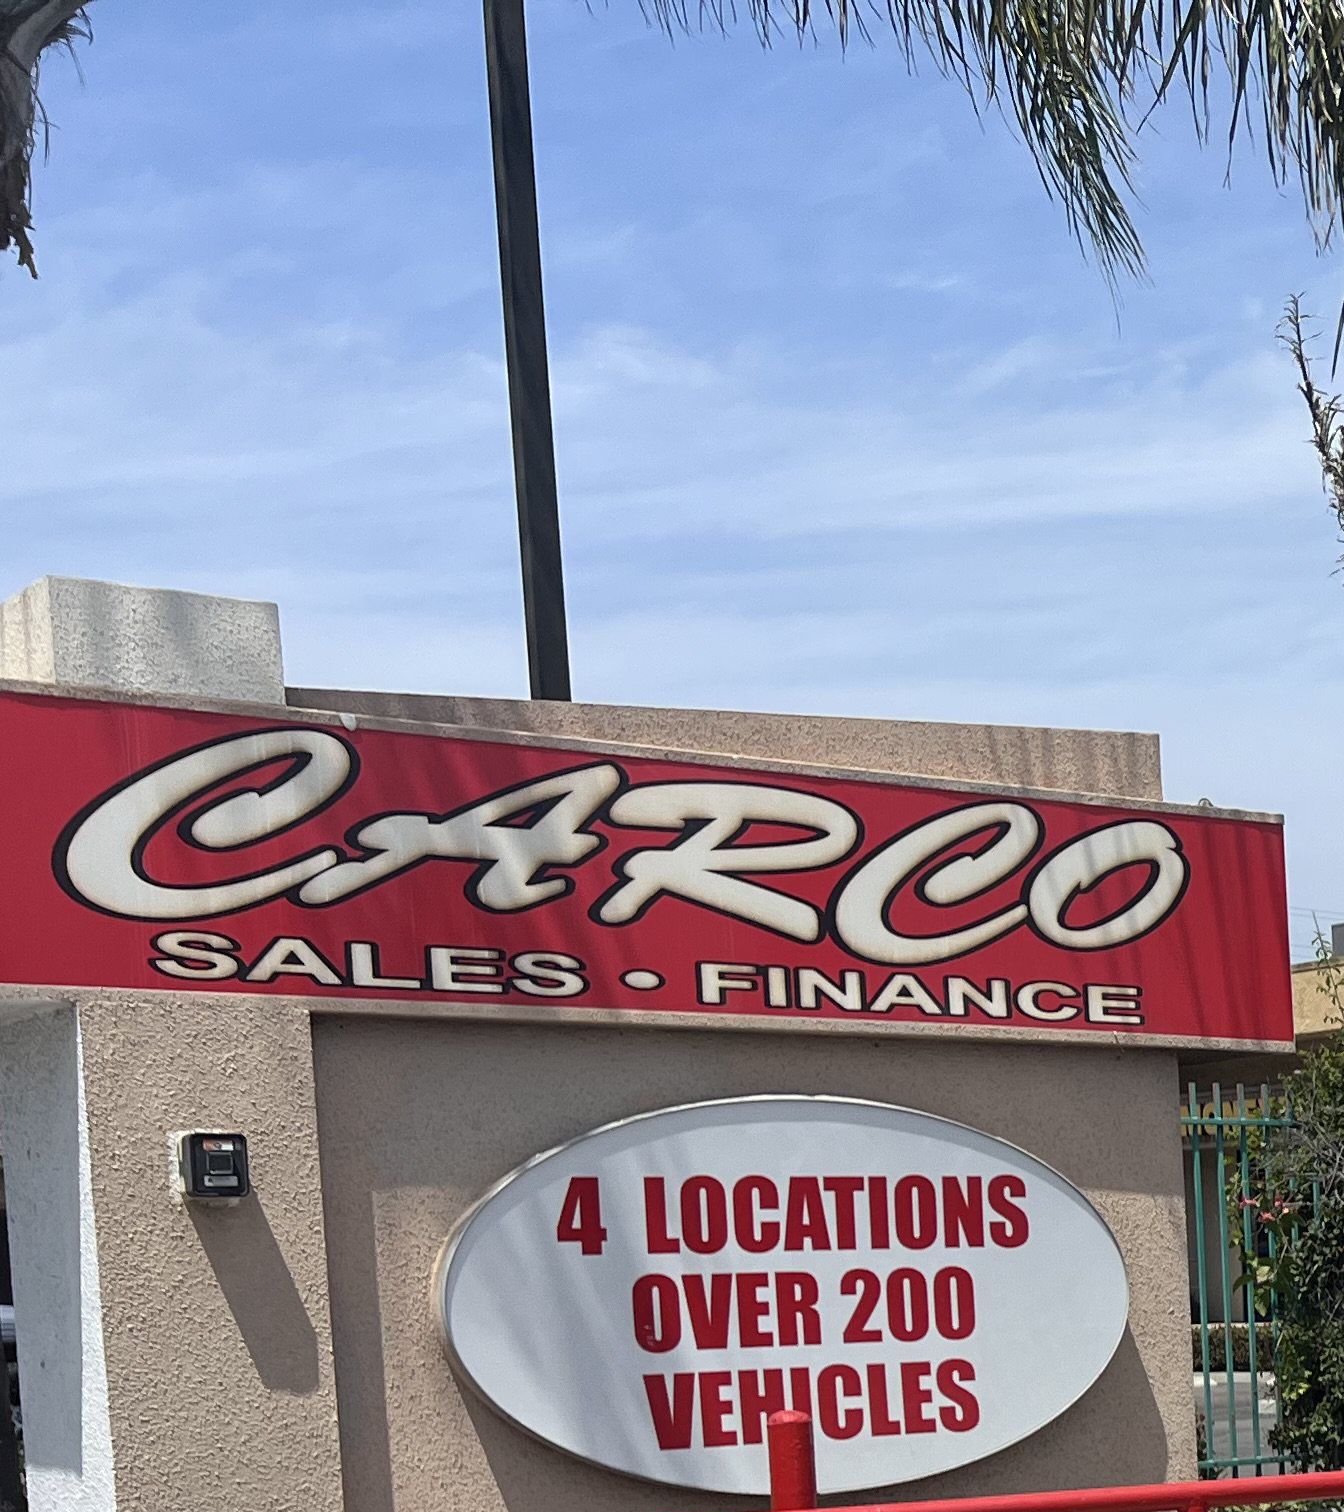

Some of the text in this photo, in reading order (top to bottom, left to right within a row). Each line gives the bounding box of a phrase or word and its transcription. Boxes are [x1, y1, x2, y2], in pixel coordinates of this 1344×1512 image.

[53, 726, 1190, 966] CARCO
[150, 929, 1145, 1028] SALES FINANCE
[556, 1174, 1029, 1255] 4 LOCATIONS
[631, 1266, 976, 1353] OVER 200
[642, 1358, 980, 1451] VEHICLES
